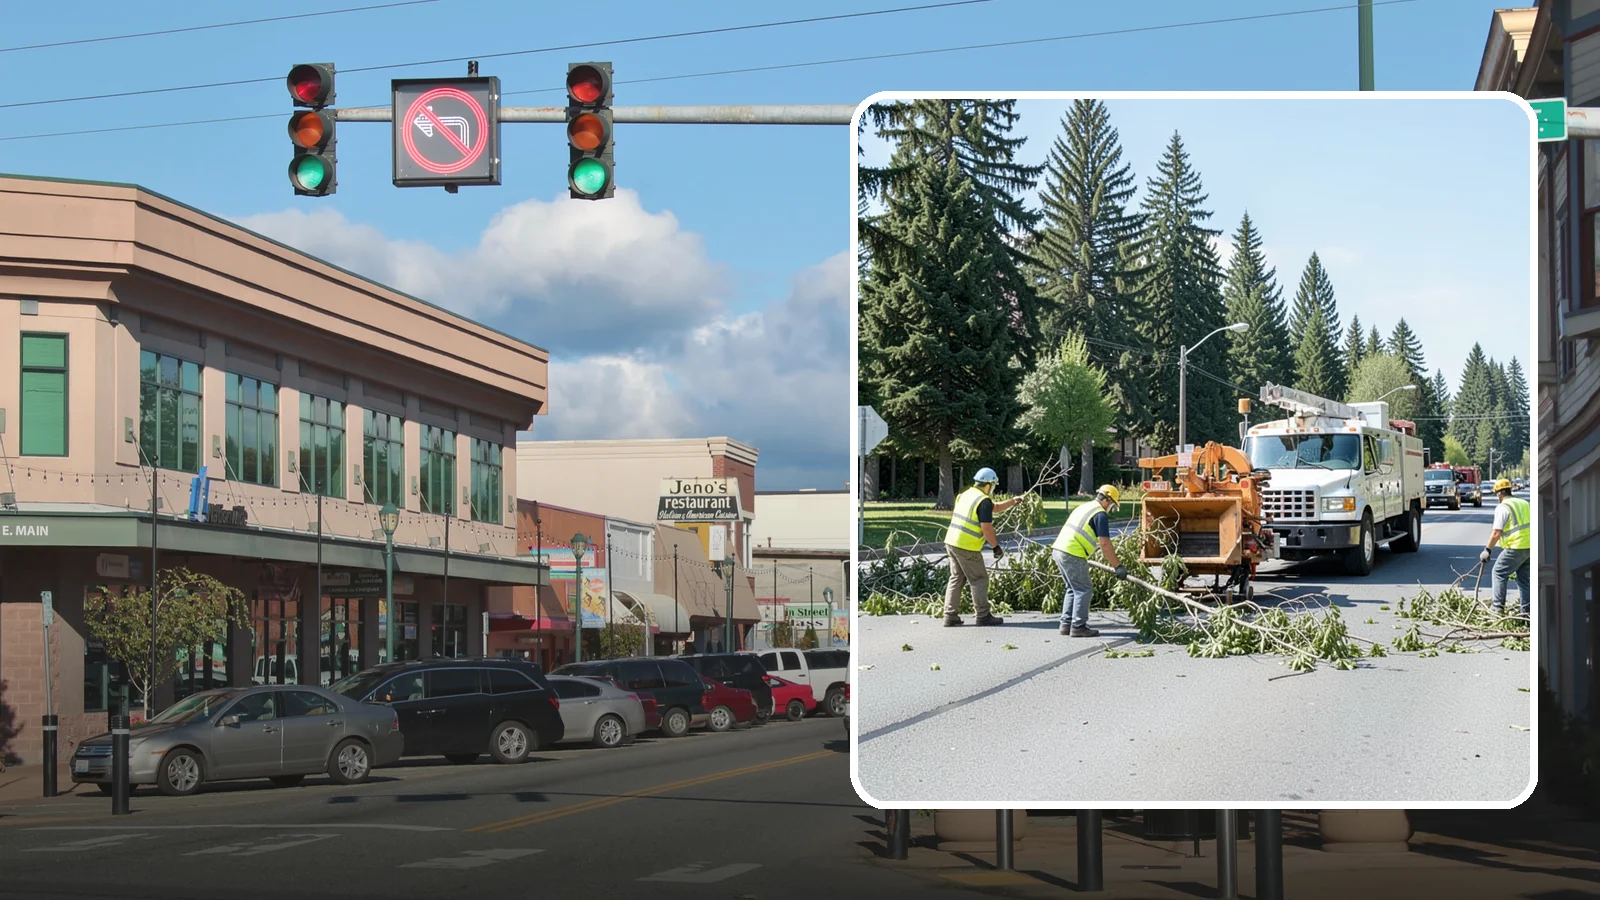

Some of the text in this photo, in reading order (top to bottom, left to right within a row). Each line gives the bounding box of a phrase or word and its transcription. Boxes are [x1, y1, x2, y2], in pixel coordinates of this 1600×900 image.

[669, 479, 728, 495] Jeno's
[665, 497, 731, 509] restaurant
[658, 510, 681, 519] Italian
[686, 510, 714, 519] American
[715, 509, 738, 519] Cuisine
[2, 525, 49, 536] E. MAIN
[797, 607, 829, 617] Street
